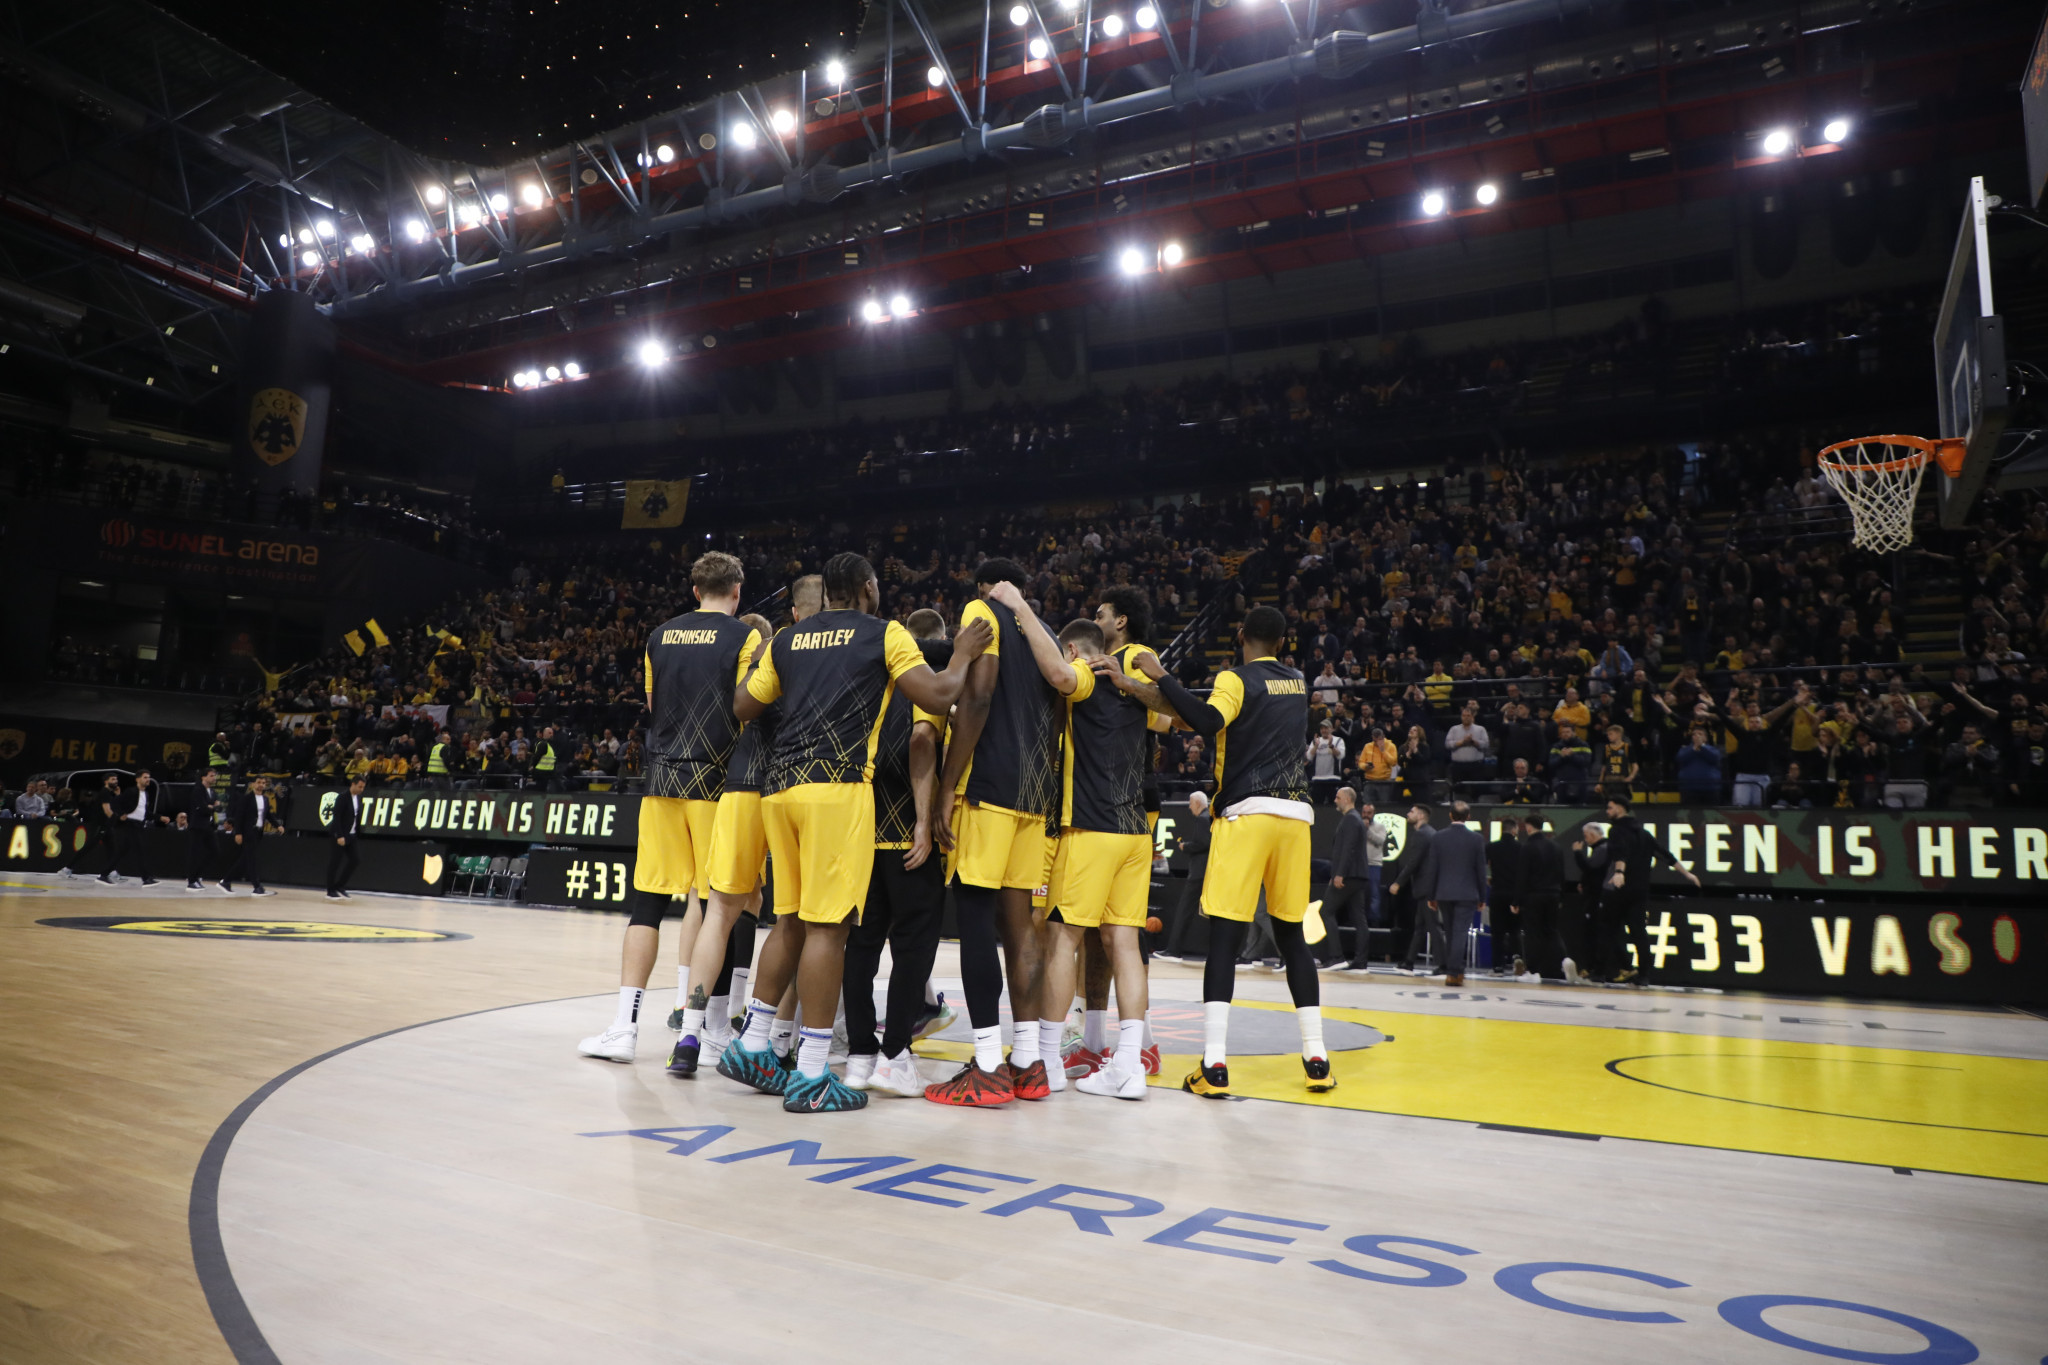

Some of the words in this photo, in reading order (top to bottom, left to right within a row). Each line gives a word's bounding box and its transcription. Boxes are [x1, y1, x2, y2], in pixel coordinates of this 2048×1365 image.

[139, 528, 233, 557] SUNEL
[238, 539, 319, 565] arena
[132, 554, 218, 574] Experience
[225, 565, 318, 582] Destination
[662, 629, 718, 645] KUZMINSKAS
[791, 629, 855, 650] BARTLEY
[51, 738, 97, 762] AEK
[107, 742, 139, 764] BC
[360, 797, 405, 828] THE
[414, 799, 496, 831] QUEEN
[507, 801, 533, 832] IS
[546, 803, 617, 837] HERE
[1817, 825, 1877, 877] IS
[1917, 826, 2048, 880] HER
[565, 860, 627, 902] #33
[1645, 911, 1765, 974] #33
[574, 1124, 1980, 1365] AMERESCO
